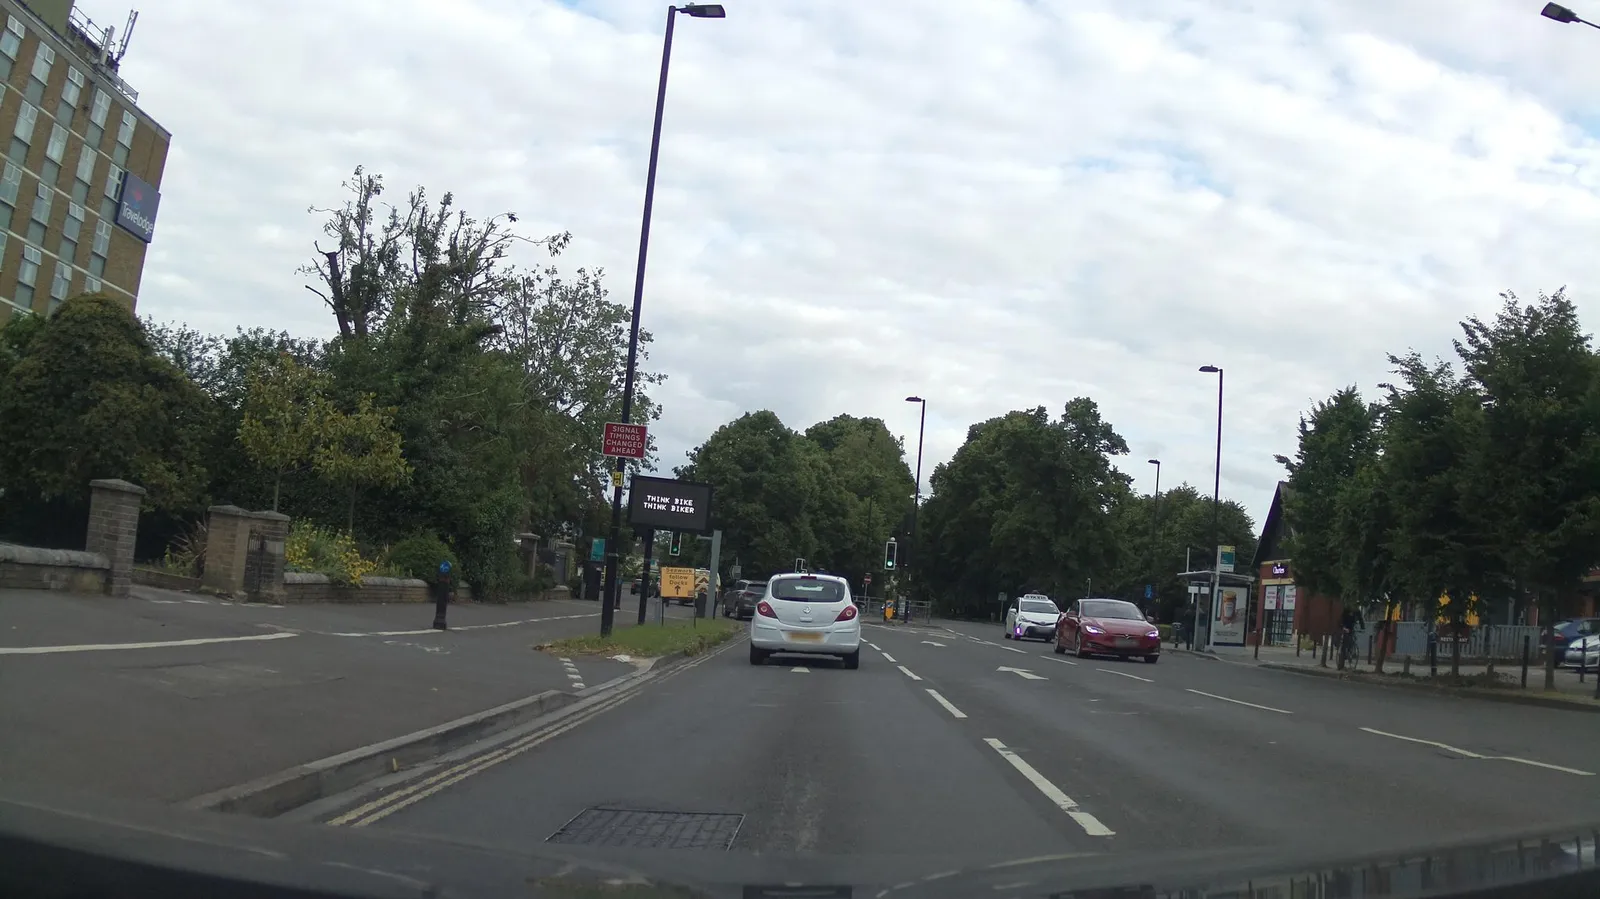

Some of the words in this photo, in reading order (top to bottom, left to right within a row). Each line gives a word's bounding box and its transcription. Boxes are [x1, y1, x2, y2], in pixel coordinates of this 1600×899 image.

[122, 202, 153, 234] Travelodge
[612, 426, 639, 434] SIGNAL
[610, 432, 640, 441] TIMINGS
[606, 439, 643, 448] CHANGED
[611, 447, 636, 455] AHEAD
[646, 495, 670, 503] THINK
[674, 498, 693, 506] BIKE
[643, 502, 667, 511] THINK
[671, 505, 695, 514] BIKER
